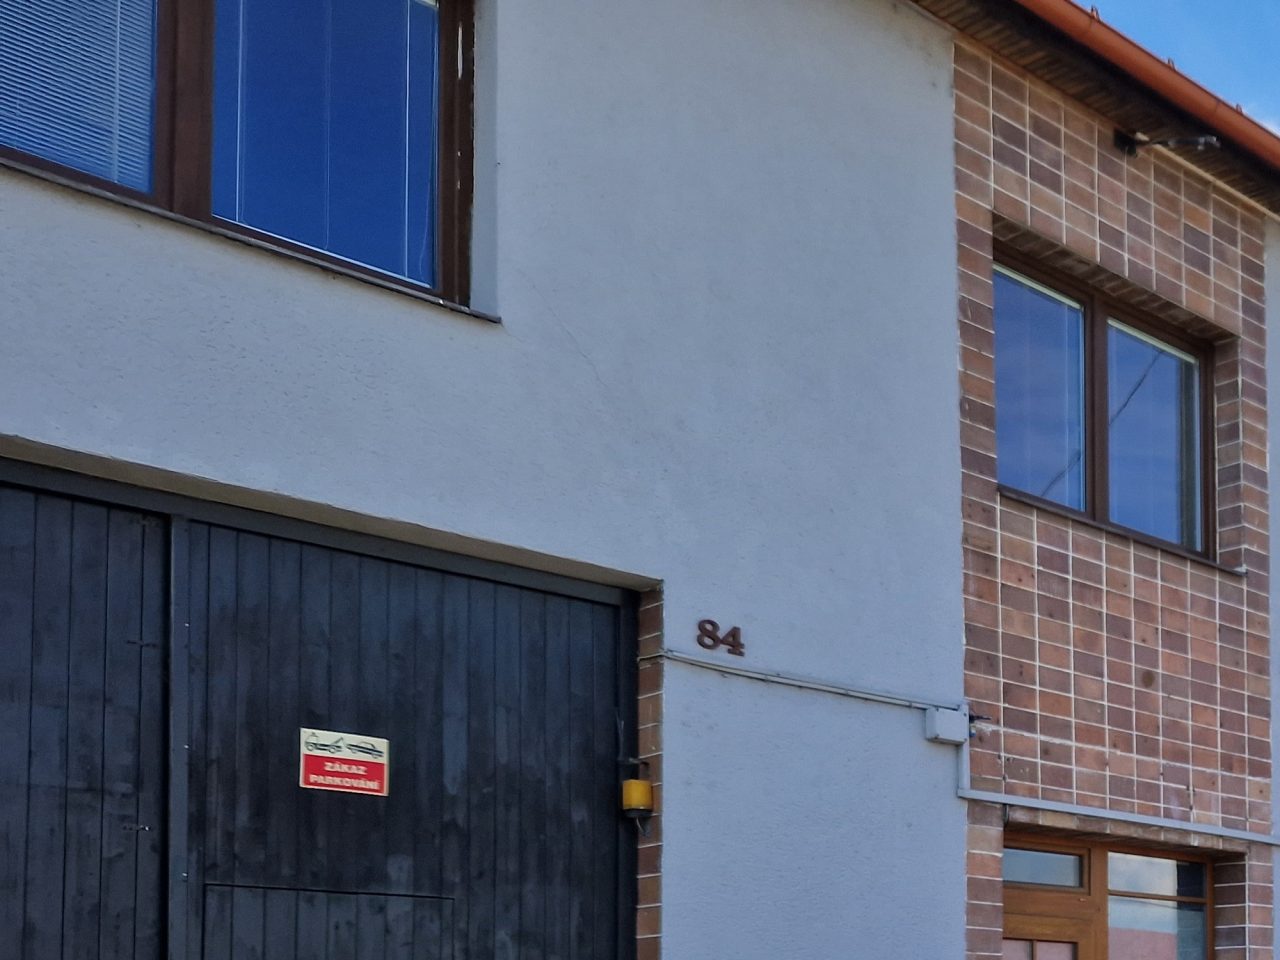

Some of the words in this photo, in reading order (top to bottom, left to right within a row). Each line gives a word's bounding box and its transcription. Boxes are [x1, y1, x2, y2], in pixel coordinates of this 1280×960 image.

[697, 619, 745, 657] 84
[324, 762, 367, 775] ZÁKAZ
[310, 775, 379, 789] PARKOVÁNÍ
